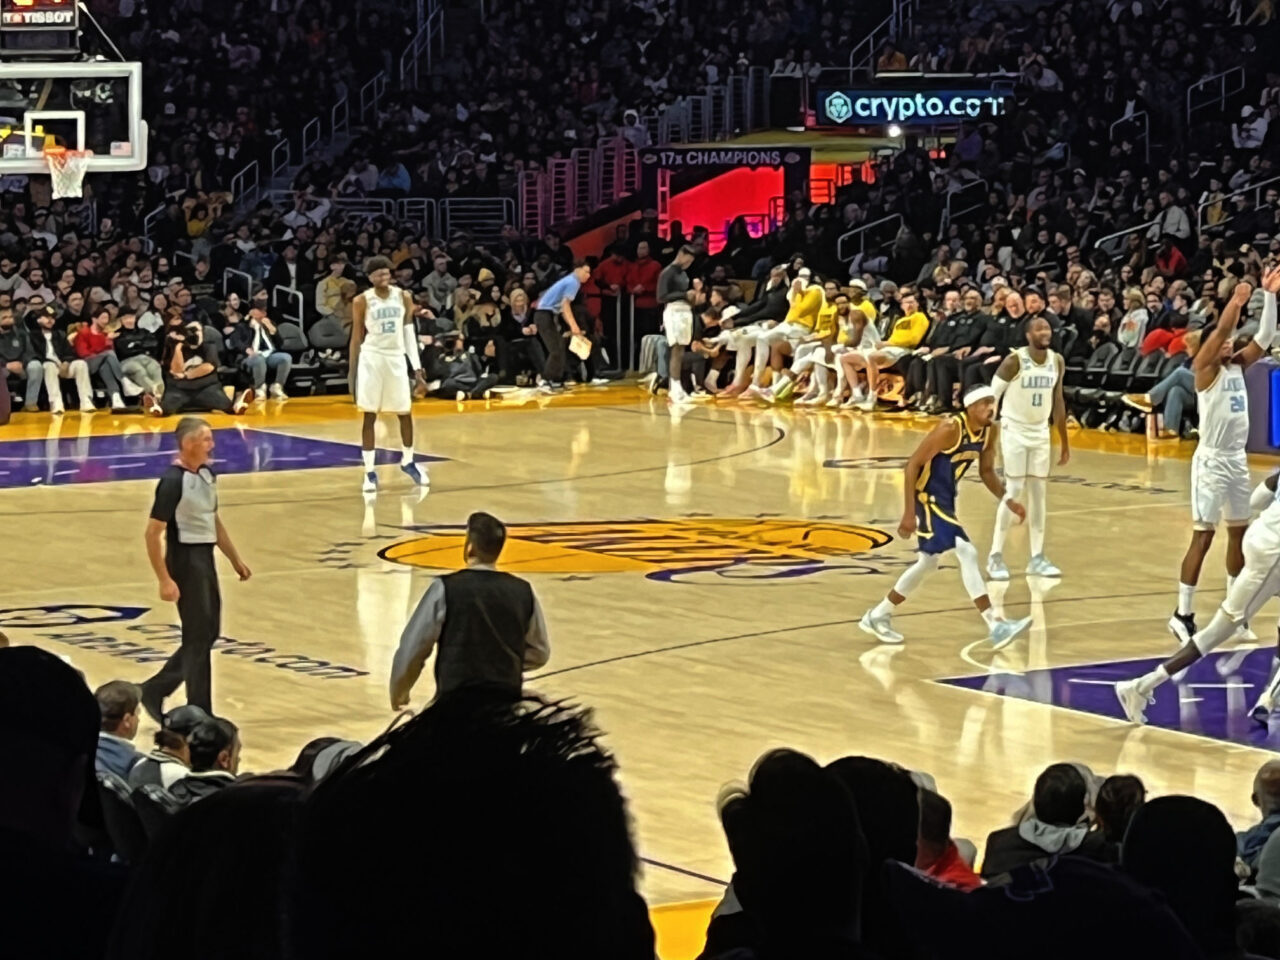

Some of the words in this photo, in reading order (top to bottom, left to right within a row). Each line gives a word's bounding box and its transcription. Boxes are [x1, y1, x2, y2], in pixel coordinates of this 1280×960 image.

[24, 11, 73, 24] TISSOT
[686, 150, 781, 165] CHAMPIONS
[381, 321, 396, 333] 12
